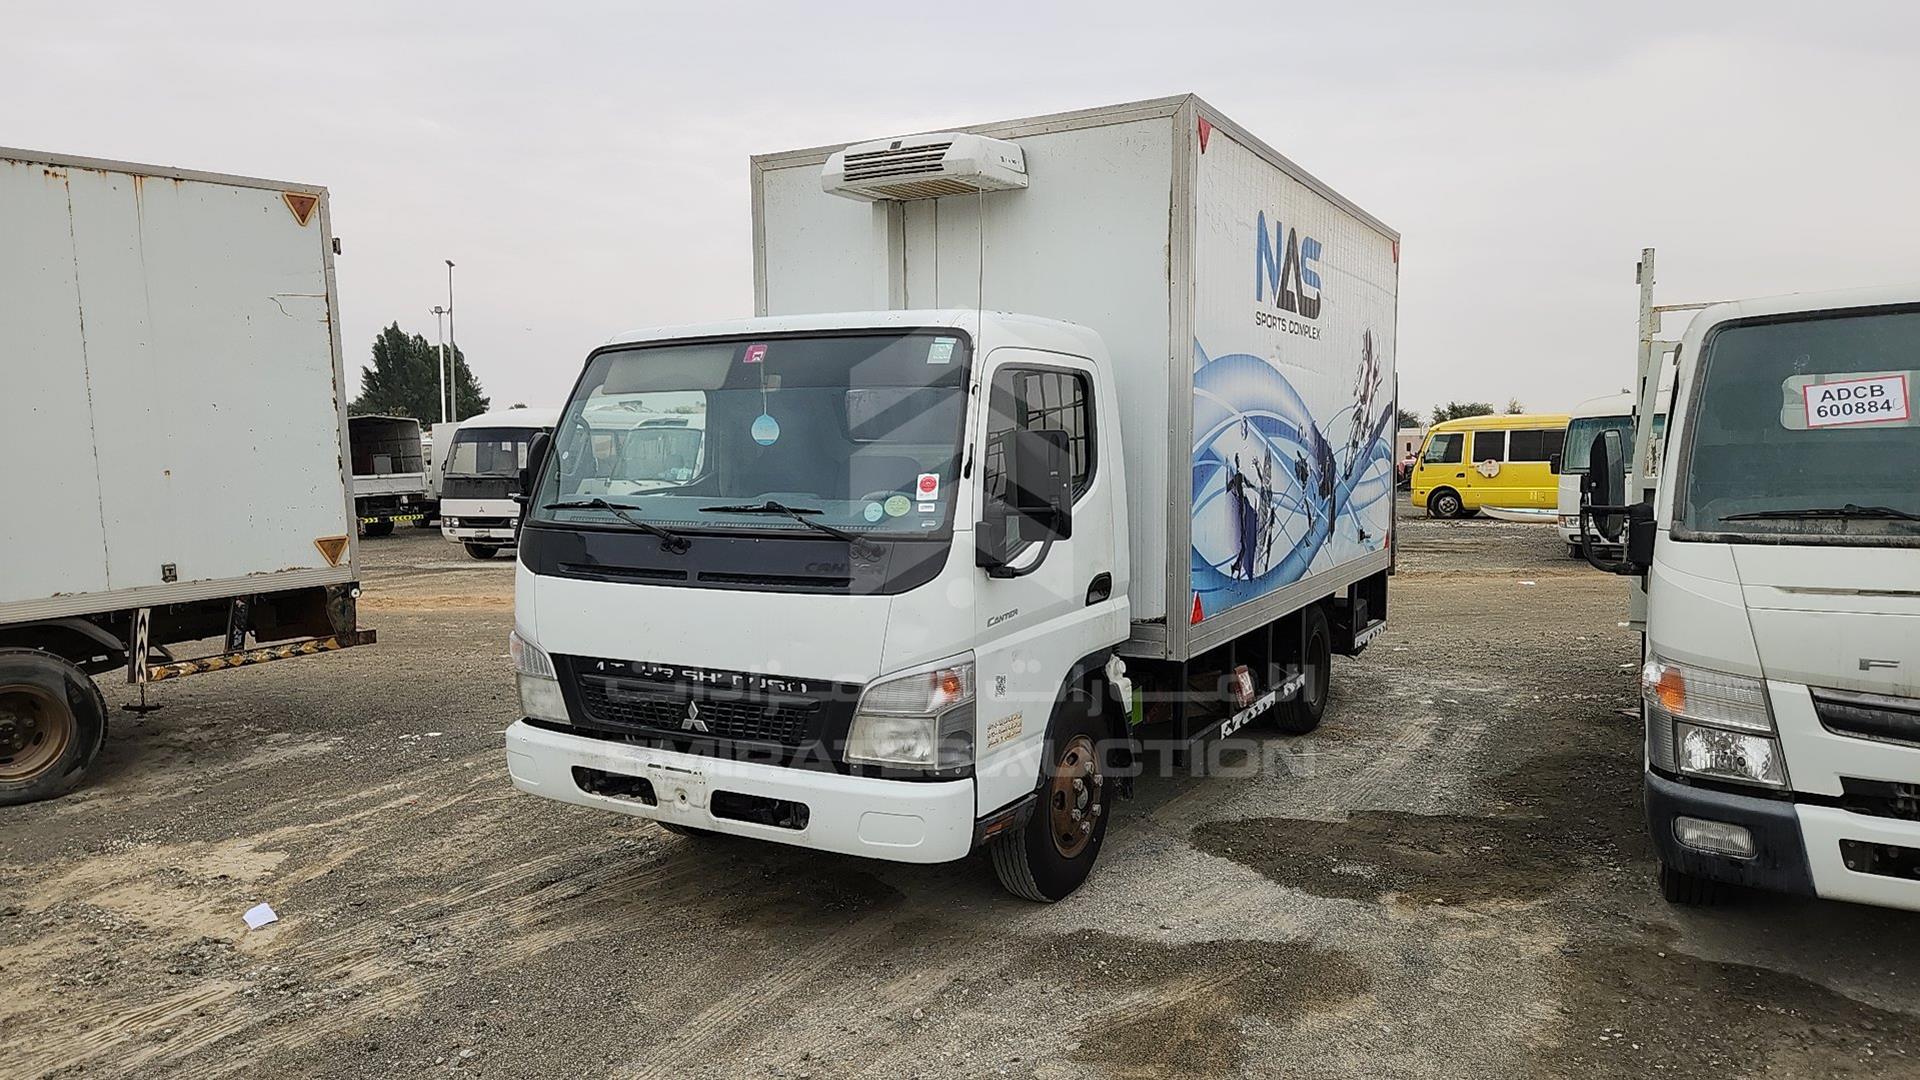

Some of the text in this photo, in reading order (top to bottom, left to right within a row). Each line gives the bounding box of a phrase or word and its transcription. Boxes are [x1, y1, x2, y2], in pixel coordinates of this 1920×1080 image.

[1256, 210, 1322, 319] NAS
[1255, 311, 1321, 341] SPORTS COMPLEX
[1820, 384, 1886, 403] ADCB
[1816, 399, 1892, 419] 600884
